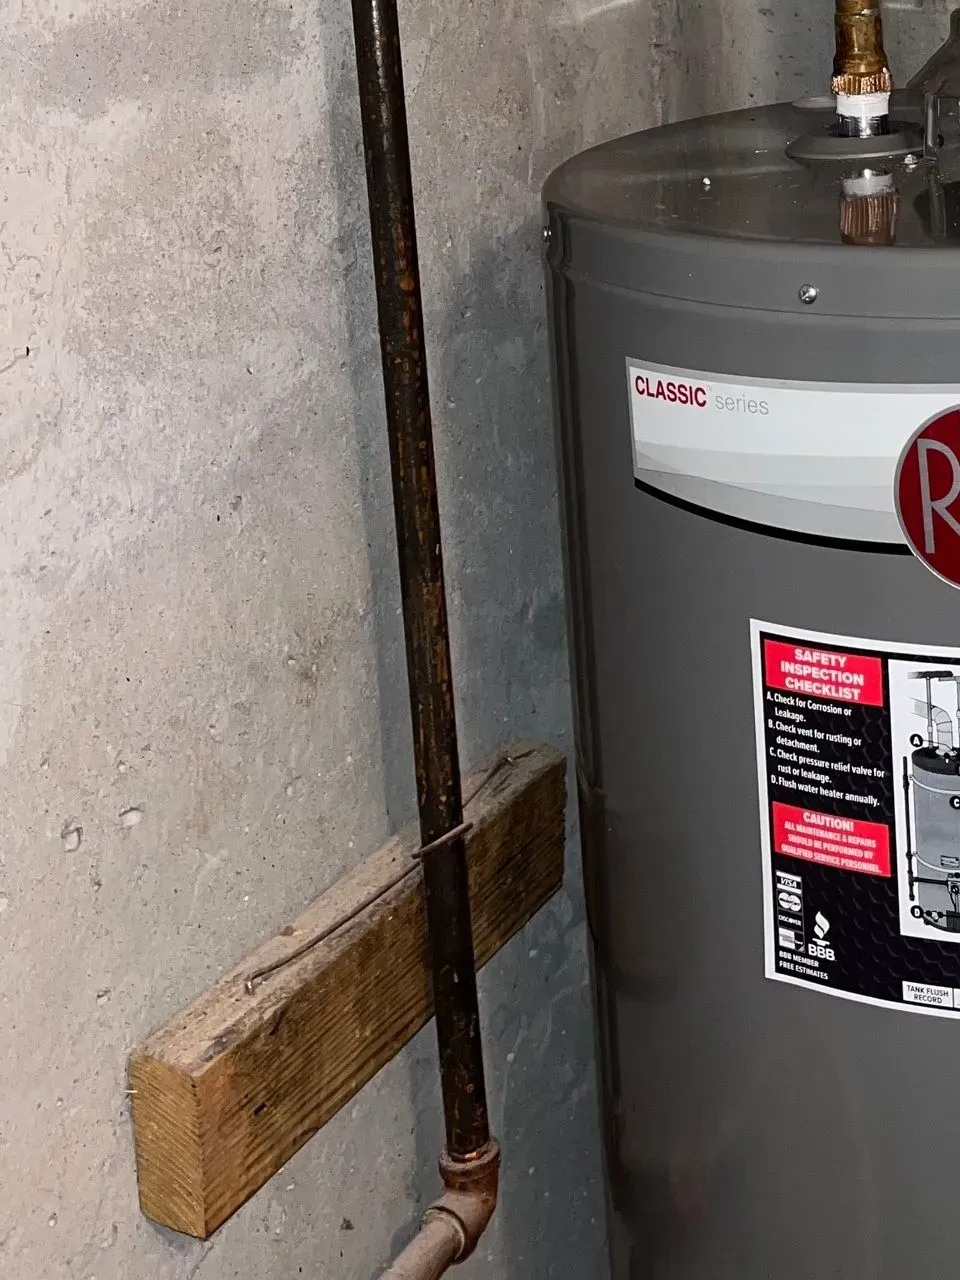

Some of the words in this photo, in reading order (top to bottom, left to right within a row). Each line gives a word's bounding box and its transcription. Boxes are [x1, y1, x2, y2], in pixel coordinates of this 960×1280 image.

[635, 376, 706, 407] CLASSIC
[715, 394, 769, 415] series
[794, 649, 847, 667] SAFETY
[780, 660, 864, 685] INSPECTION
[785, 677, 861, 700] CHECKLIST
[774, 693, 794, 705] Check
[796, 697, 806, 707] for
[807, 700, 842, 714] Corrosion
[844, 708, 851, 716] or
[775, 707, 806, 722] Leakage.
[776, 721, 796, 733] Check
[797, 727, 813, 738] vent
[814, 729, 825, 740] for
[826, 732, 852, 746] rusting
[854, 738, 862, 746] or
[776, 736, 820, 753] detachment.
[777, 749, 797, 762] Check
[799, 755, 830, 769] pressure
[831, 761, 850, 772] relief
[852, 765, 872, 776] valve
[873, 768, 885, 778] for
[778, 765, 791, 774] rust
[792, 768, 800, 776] or
[801, 768, 832, 784] leakage.
[779, 776, 796, 789] Flush
[798, 783, 819, 794] water
[820, 787, 843, 799] heater
[845, 793, 880, 807] annually.
[803, 812, 854, 832] CAUTION!
[784, 821, 795, 831] ALL
[796, 824, 842, 841] MAINTENANCE
[847, 836, 877, 848] REPAIRS
[781, 843, 813, 859] QUALIFIED
[813, 851, 841, 865] SERVICE
[788, 834, 813, 847] SHOULD
[813, 839, 823, 849] BE
[823, 841, 863, 859] PERFORMED
[864, 850, 874, 859] BY
[780, 877, 797, 888] VISA
[779, 951, 792, 960] BBB
[793, 954, 819, 967] MEMBER
[808, 943, 835, 961] BBB
[779, 961, 795, 971] FREE
[795, 964, 829, 980] ESTIMATES
[907, 985, 925, 994] TANK
[926, 987, 949, 998] FLUSH
[914, 994, 943, 1004] RECORD
